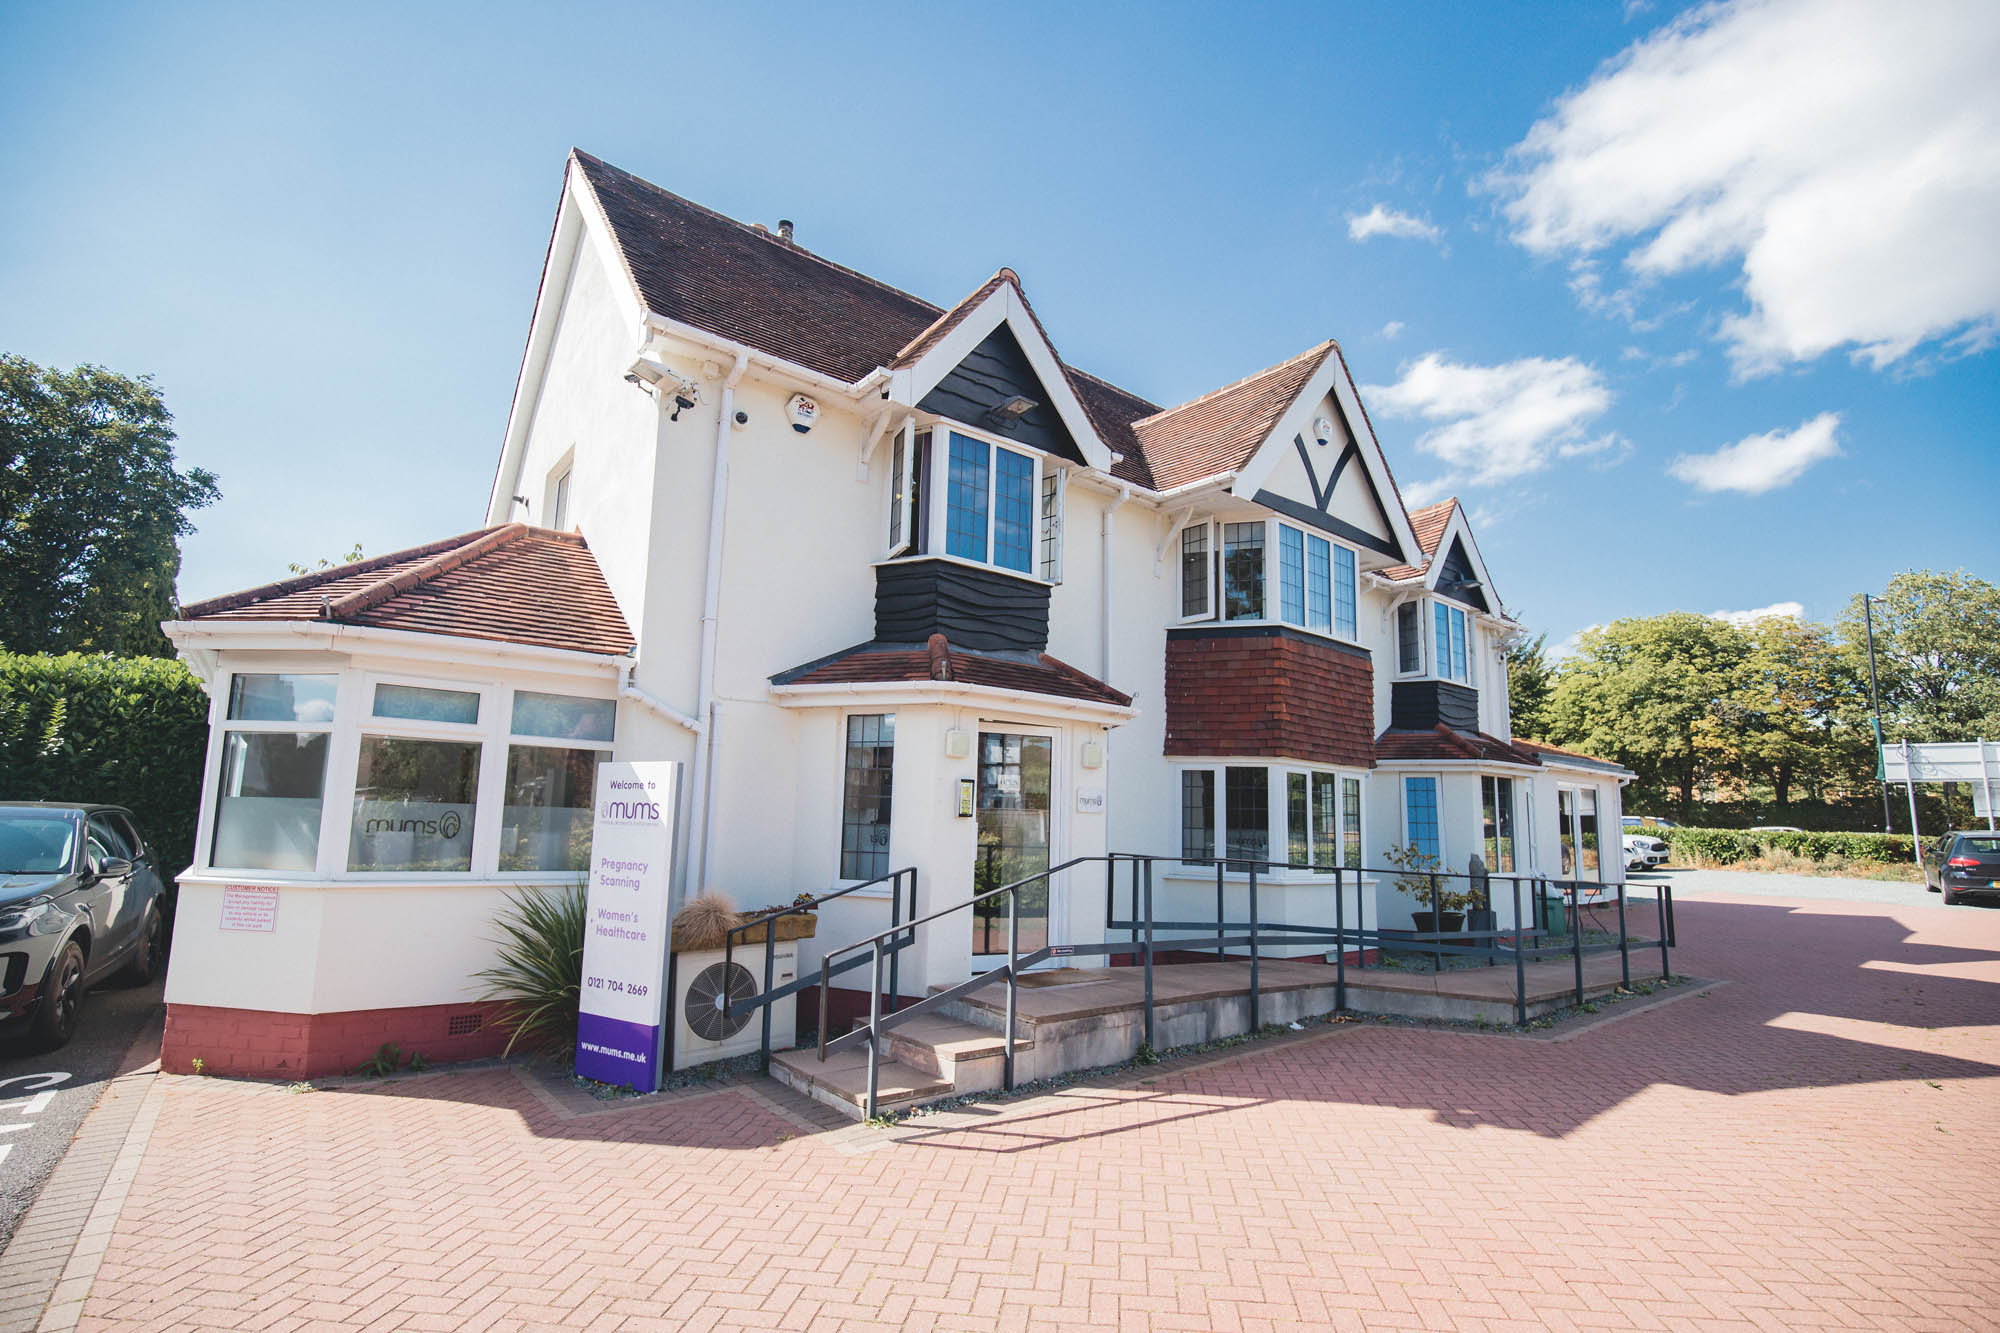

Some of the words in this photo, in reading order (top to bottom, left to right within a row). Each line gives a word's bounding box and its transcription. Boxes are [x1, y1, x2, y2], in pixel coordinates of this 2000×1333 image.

[610, 780, 644, 790] Welcome
[648, 781, 656, 790] to
[609, 801, 660, 820] mums
[366, 818, 437, 834] mums
[601, 857, 648, 874] Pregnancy
[600, 874, 640, 891] Scanning
[598, 908, 639, 923] Women's
[596, 924, 646, 941] Healthcare
[587, 976, 604, 989] 0121
[608, 980, 623, 992] 704
[627, 983, 648, 996] 2669
[581, 1041, 646, 1063] www.mums.me.uk
